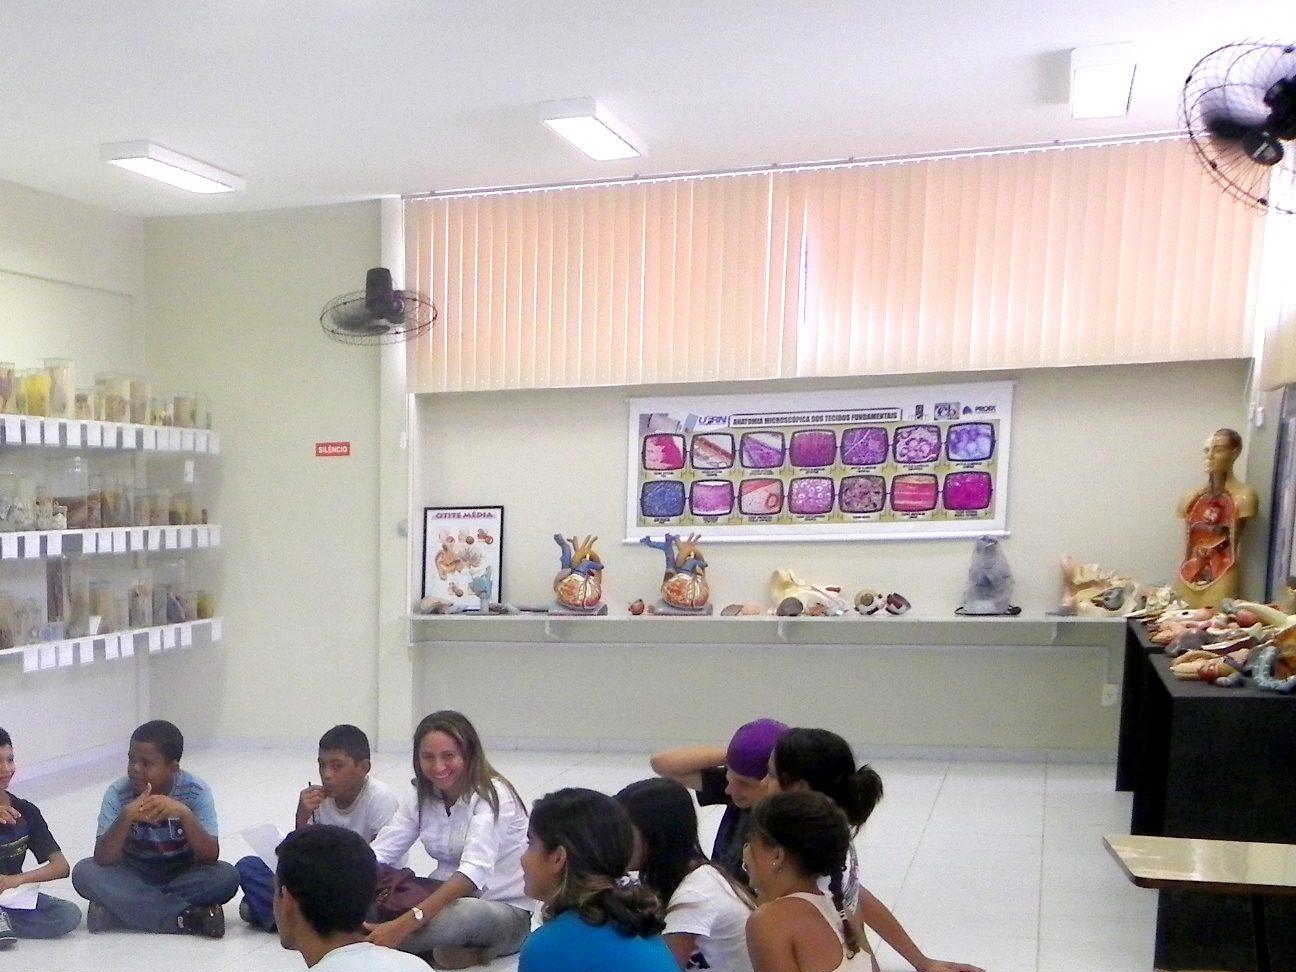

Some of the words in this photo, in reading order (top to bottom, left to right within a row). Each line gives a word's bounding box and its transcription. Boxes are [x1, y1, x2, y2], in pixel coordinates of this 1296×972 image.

[733, 417, 763, 425] ANATOMIA
[764, 415, 810, 424] MICROSCÓPICA
[825, 414, 850, 422] TECIDOS
[851, 412, 898, 420] FUNDAMENTAIS
